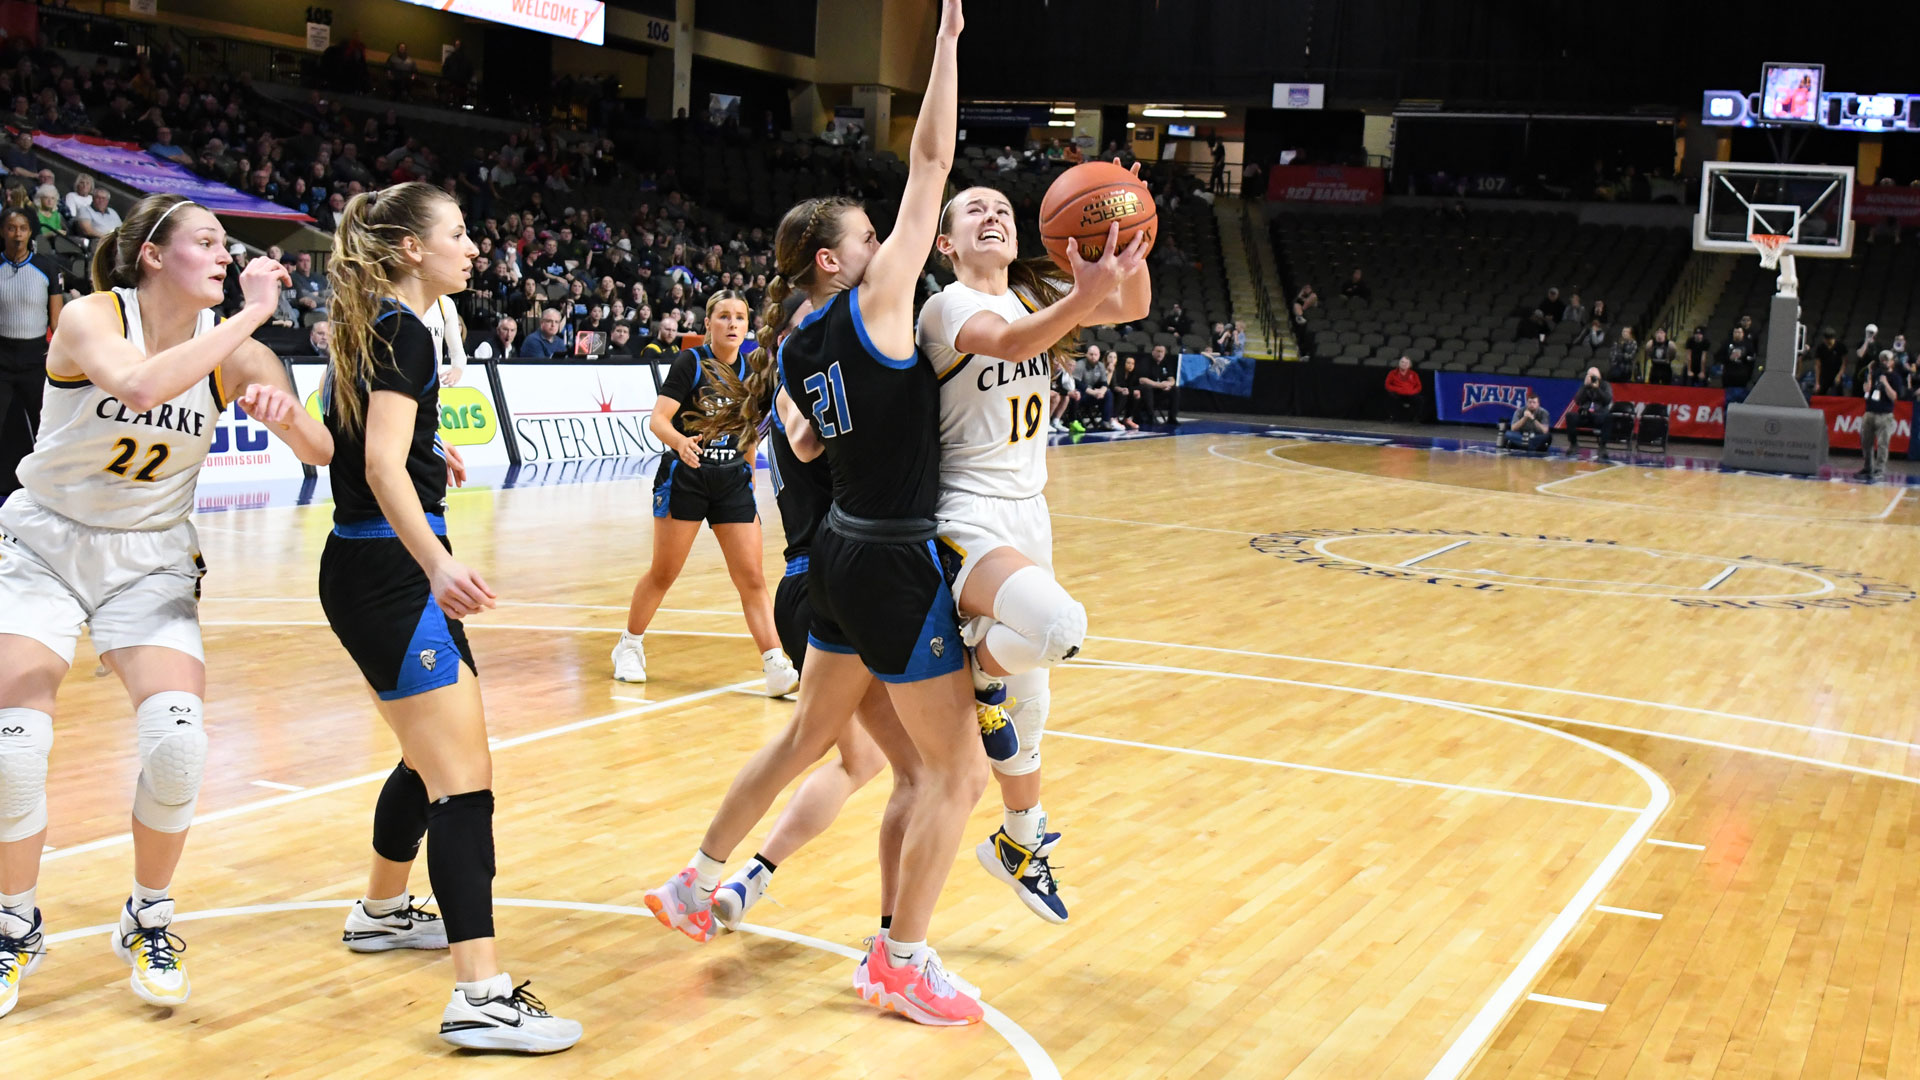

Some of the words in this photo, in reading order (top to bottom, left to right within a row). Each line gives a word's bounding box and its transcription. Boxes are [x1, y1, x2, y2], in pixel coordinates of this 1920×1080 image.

[511, 0, 579, 26] WELCOME
[647, 21, 669, 42] 106
[1478, 177, 1506, 191] 107
[1080, 201, 1146, 228] LEGACY
[977, 351, 1050, 392] CLARK
[803, 360, 853, 439] 21
[1462, 383, 1528, 410] NAIA
[438, 403, 487, 430] ars
[103, 436, 171, 482] 22
[696, 448, 737, 460] TATE
